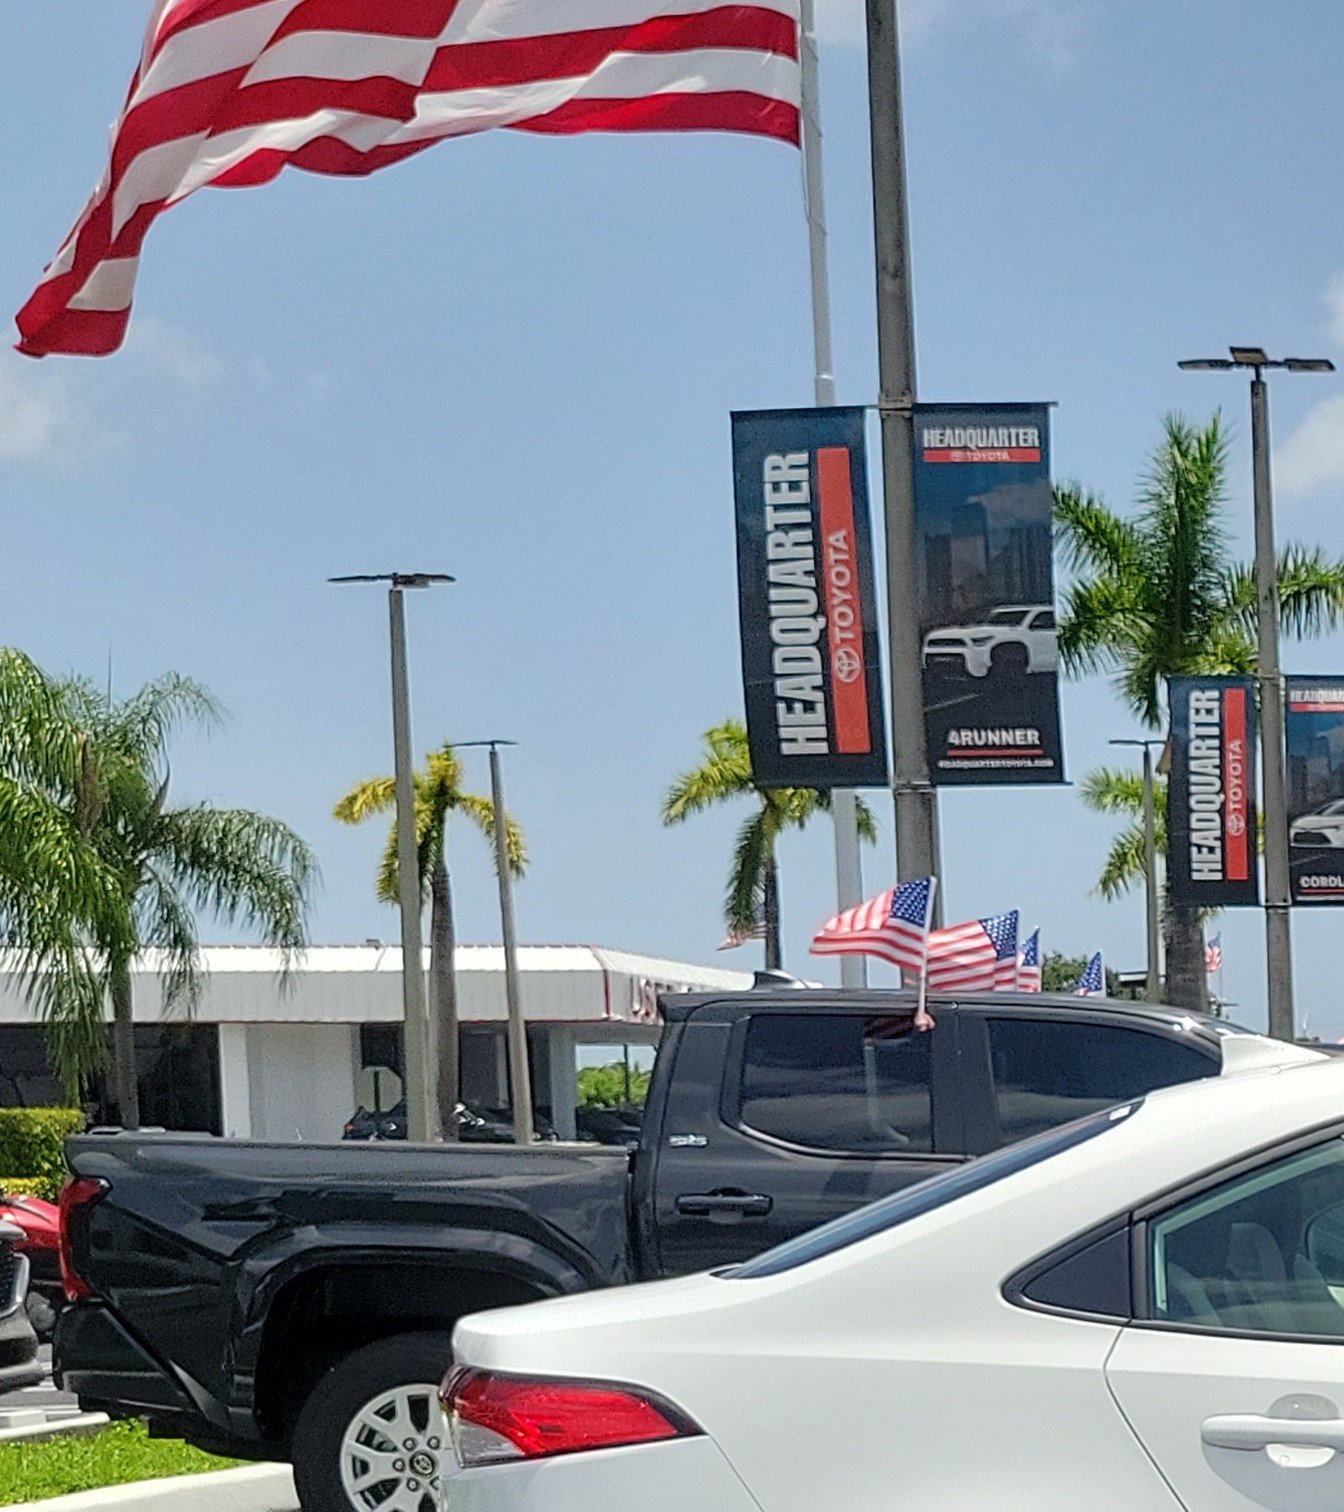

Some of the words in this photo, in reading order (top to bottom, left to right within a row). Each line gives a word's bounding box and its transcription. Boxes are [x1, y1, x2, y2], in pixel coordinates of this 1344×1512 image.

[923, 428, 1039, 449] HEADQUARTER
[764, 451, 829, 755] HEADQUARTER
[828, 530, 857, 644] TOYOTA
[947, 728, 1040, 745] 4RUNNER
[1229, 740, 1242, 809] TOYOTA
[1189, 689, 1225, 880] HEADQUARTER
